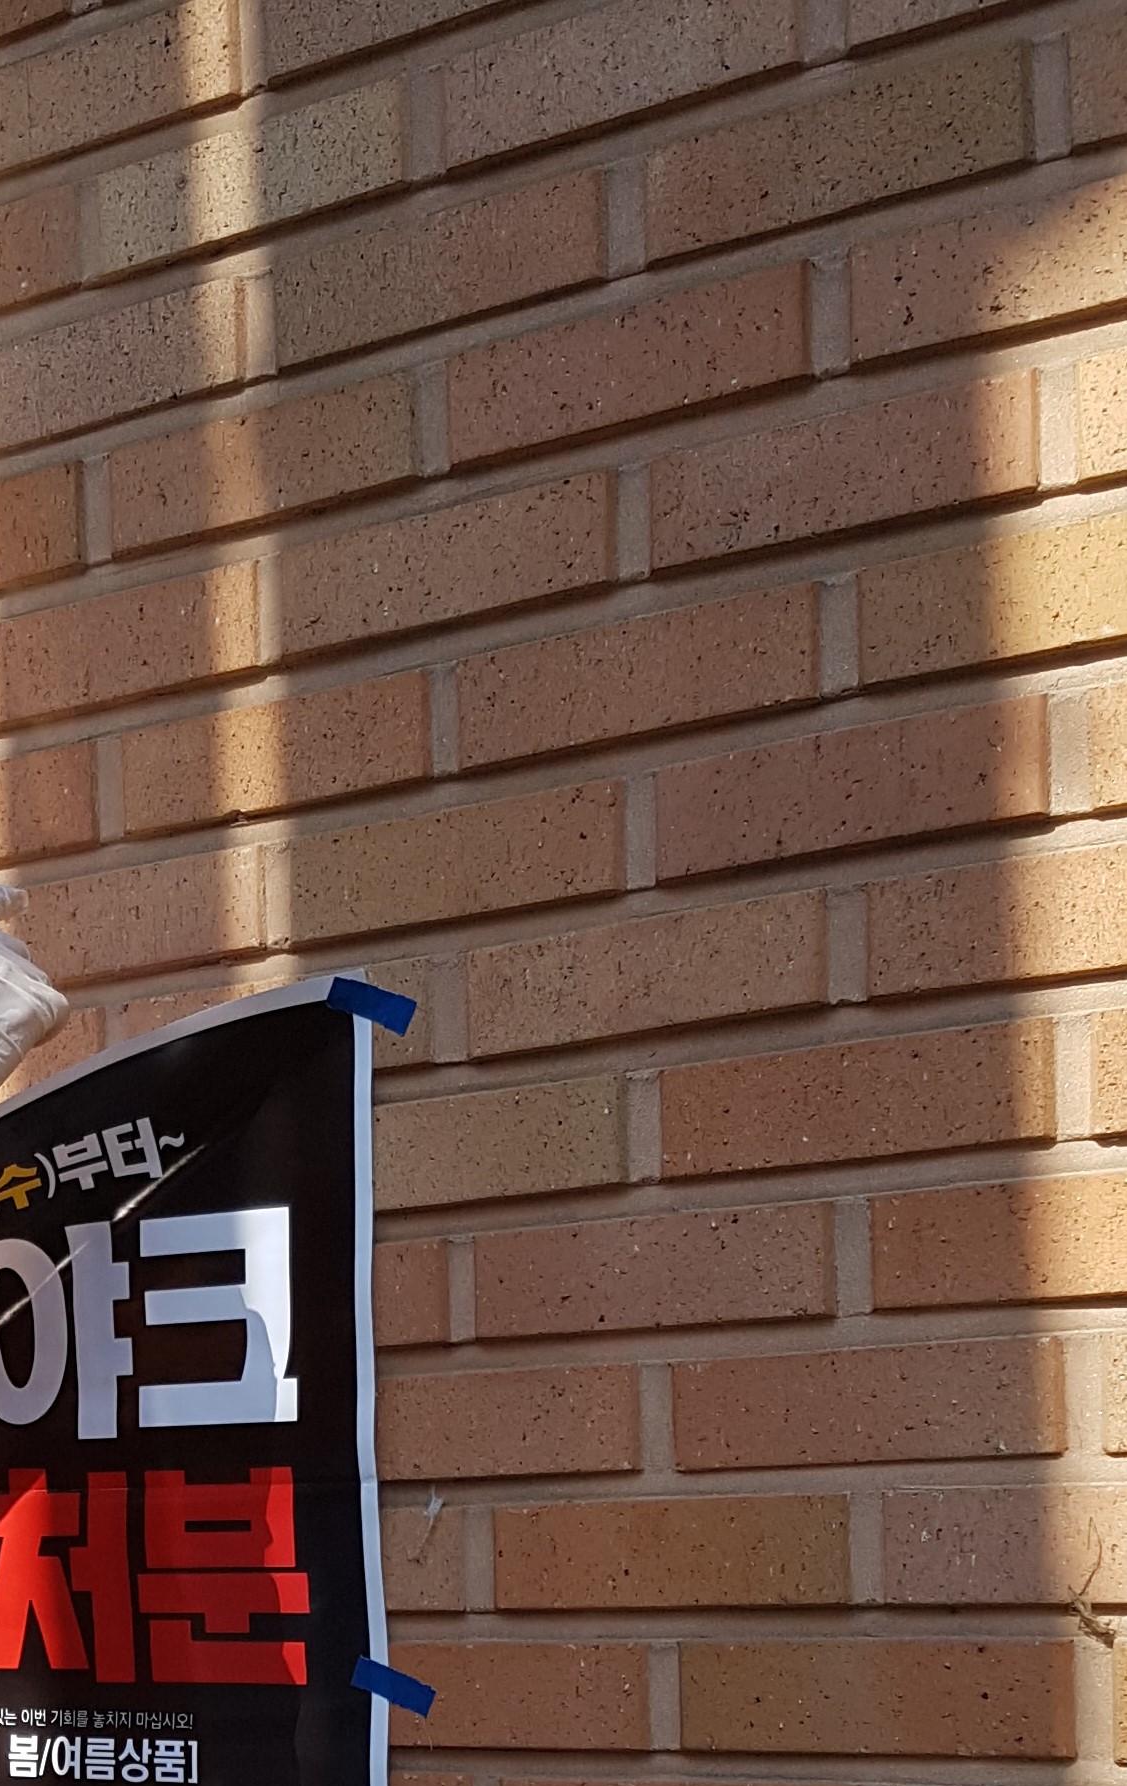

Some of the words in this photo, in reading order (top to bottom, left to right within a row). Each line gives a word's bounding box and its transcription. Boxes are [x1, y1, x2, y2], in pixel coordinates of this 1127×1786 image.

[21, 1708, 46, 1727] 이번
[50, 1708, 89, 1728] 기회를
[92, 1710, 132, 1729] 놓치지
[136, 1711, 194, 1730] 마십시오!
[8, 1733, 199, 1784] 봄/여름상품]
